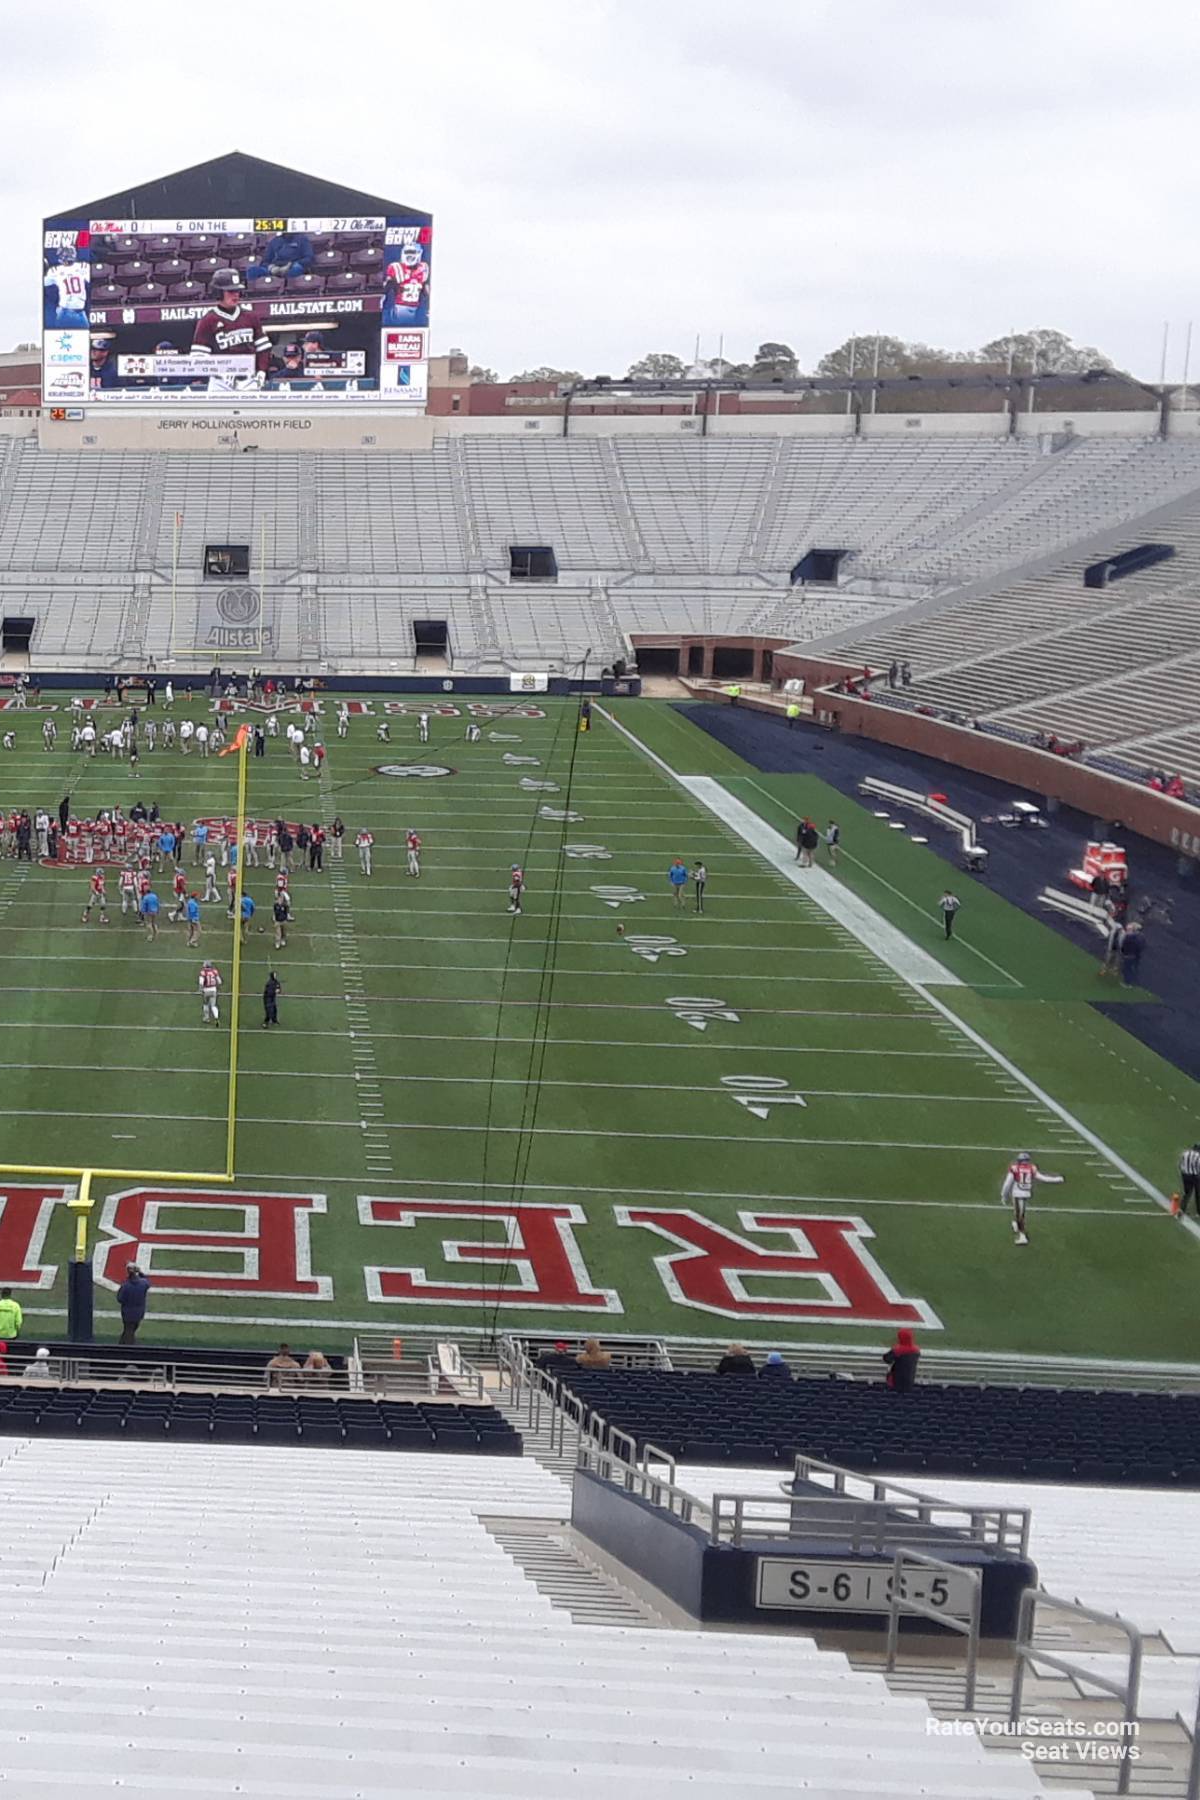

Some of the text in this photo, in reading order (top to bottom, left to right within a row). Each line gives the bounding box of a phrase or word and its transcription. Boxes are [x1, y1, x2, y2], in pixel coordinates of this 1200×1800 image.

[131, 222, 138, 232] 0
[189, 222, 205, 231] ON
[208, 222, 227, 231] THE
[255, 219, 284, 230] 25:14
[303, 220, 308, 230] 1
[333, 219, 347, 230] 27
[63, 276, 81, 295] 10
[270, 299, 363, 315] HAILSTATE.COM
[51, 409, 65, 420] 25
[158, 419, 312, 430] JERRY HOLLINGSWORTH FIELD
[207, 627, 271, 646] Allstate
[208, 699, 547, 717] MISS
[720, 1075, 808, 1108] 10
[788, 1570, 852, 1602] S-6
